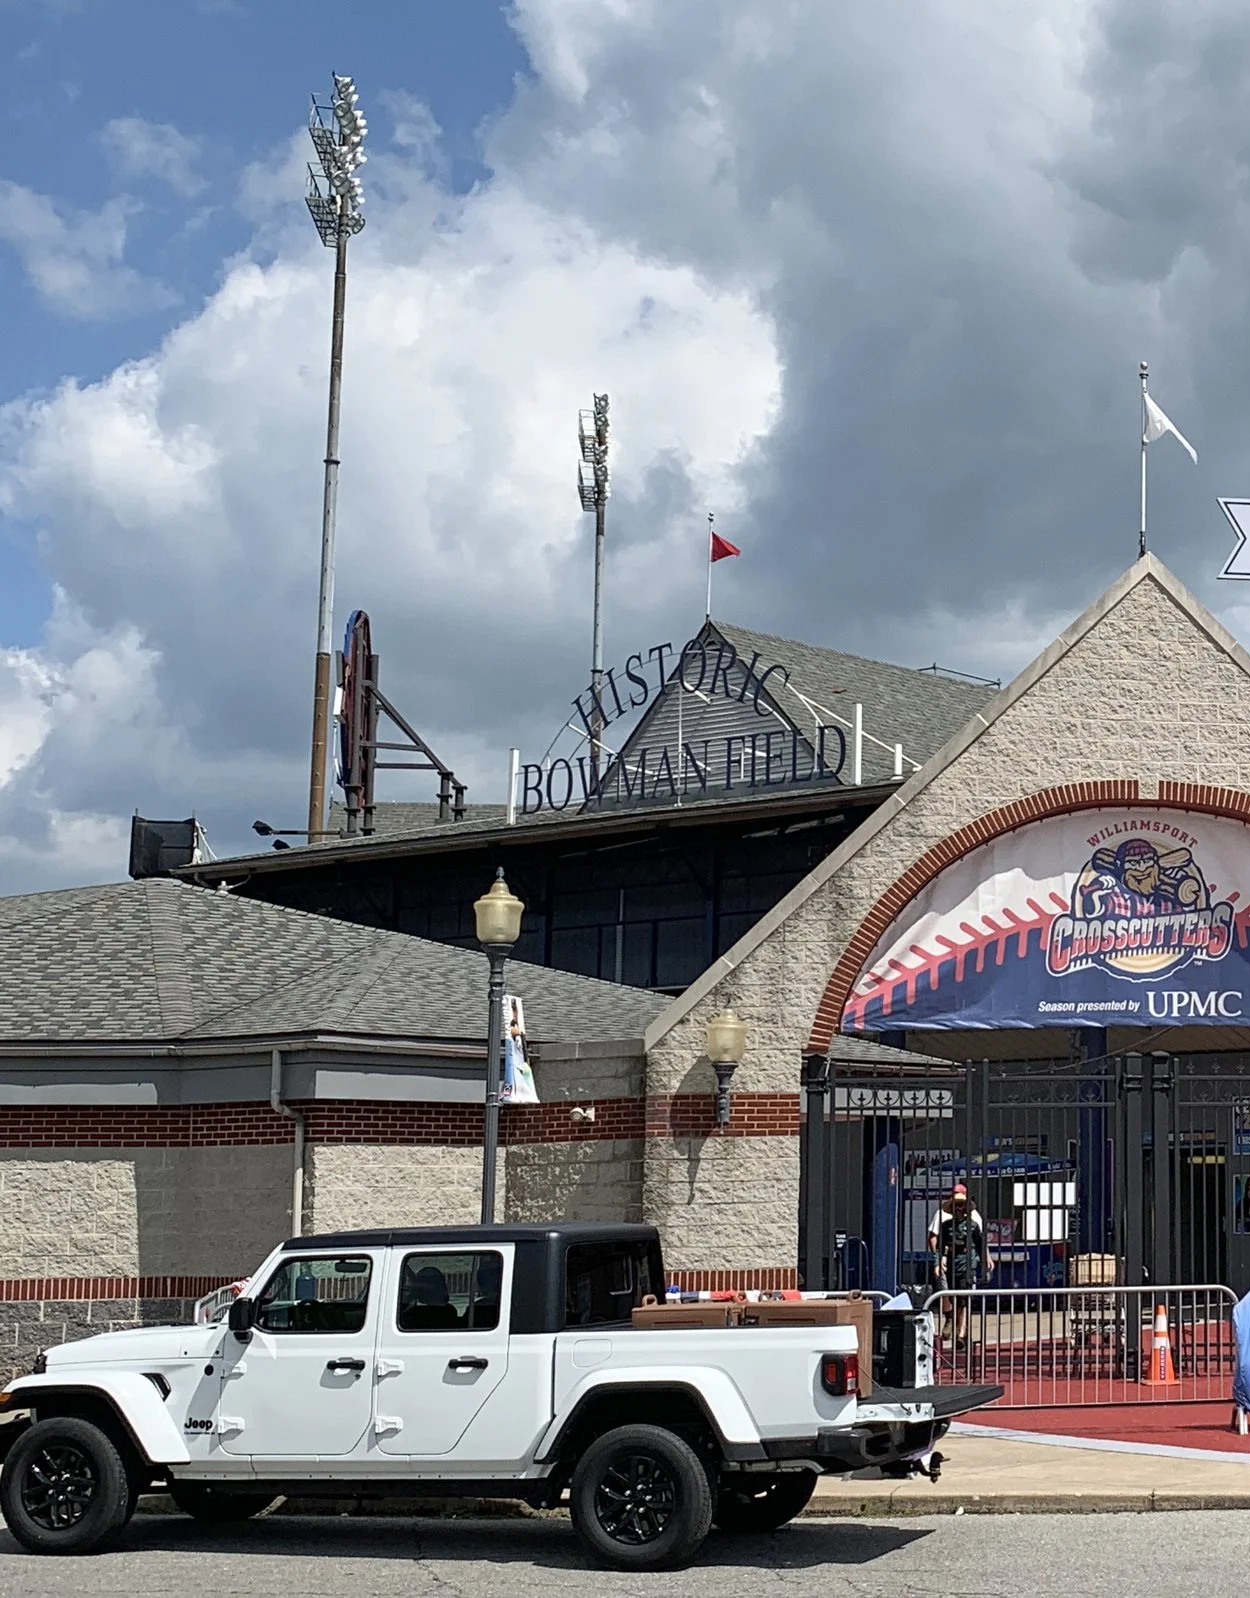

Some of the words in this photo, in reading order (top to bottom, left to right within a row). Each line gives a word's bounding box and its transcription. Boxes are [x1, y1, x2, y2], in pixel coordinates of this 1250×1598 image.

[572, 637, 791, 740] HISTORIC
[520, 739, 713, 816] BOWMAN
[724, 724, 847, 790] FIELD
[1086, 819, 1199, 848] WILLIAMSPORT
[1051, 902, 1231, 972] CROSSCUTTERS
[1038, 1001, 1075, 1013] Season
[1077, 1000, 1127, 1013] presented
[1128, 1000, 1141, 1012] by
[1146, 990, 1243, 1018] UPMC
[184, 1417, 213, 1431] Jeep
